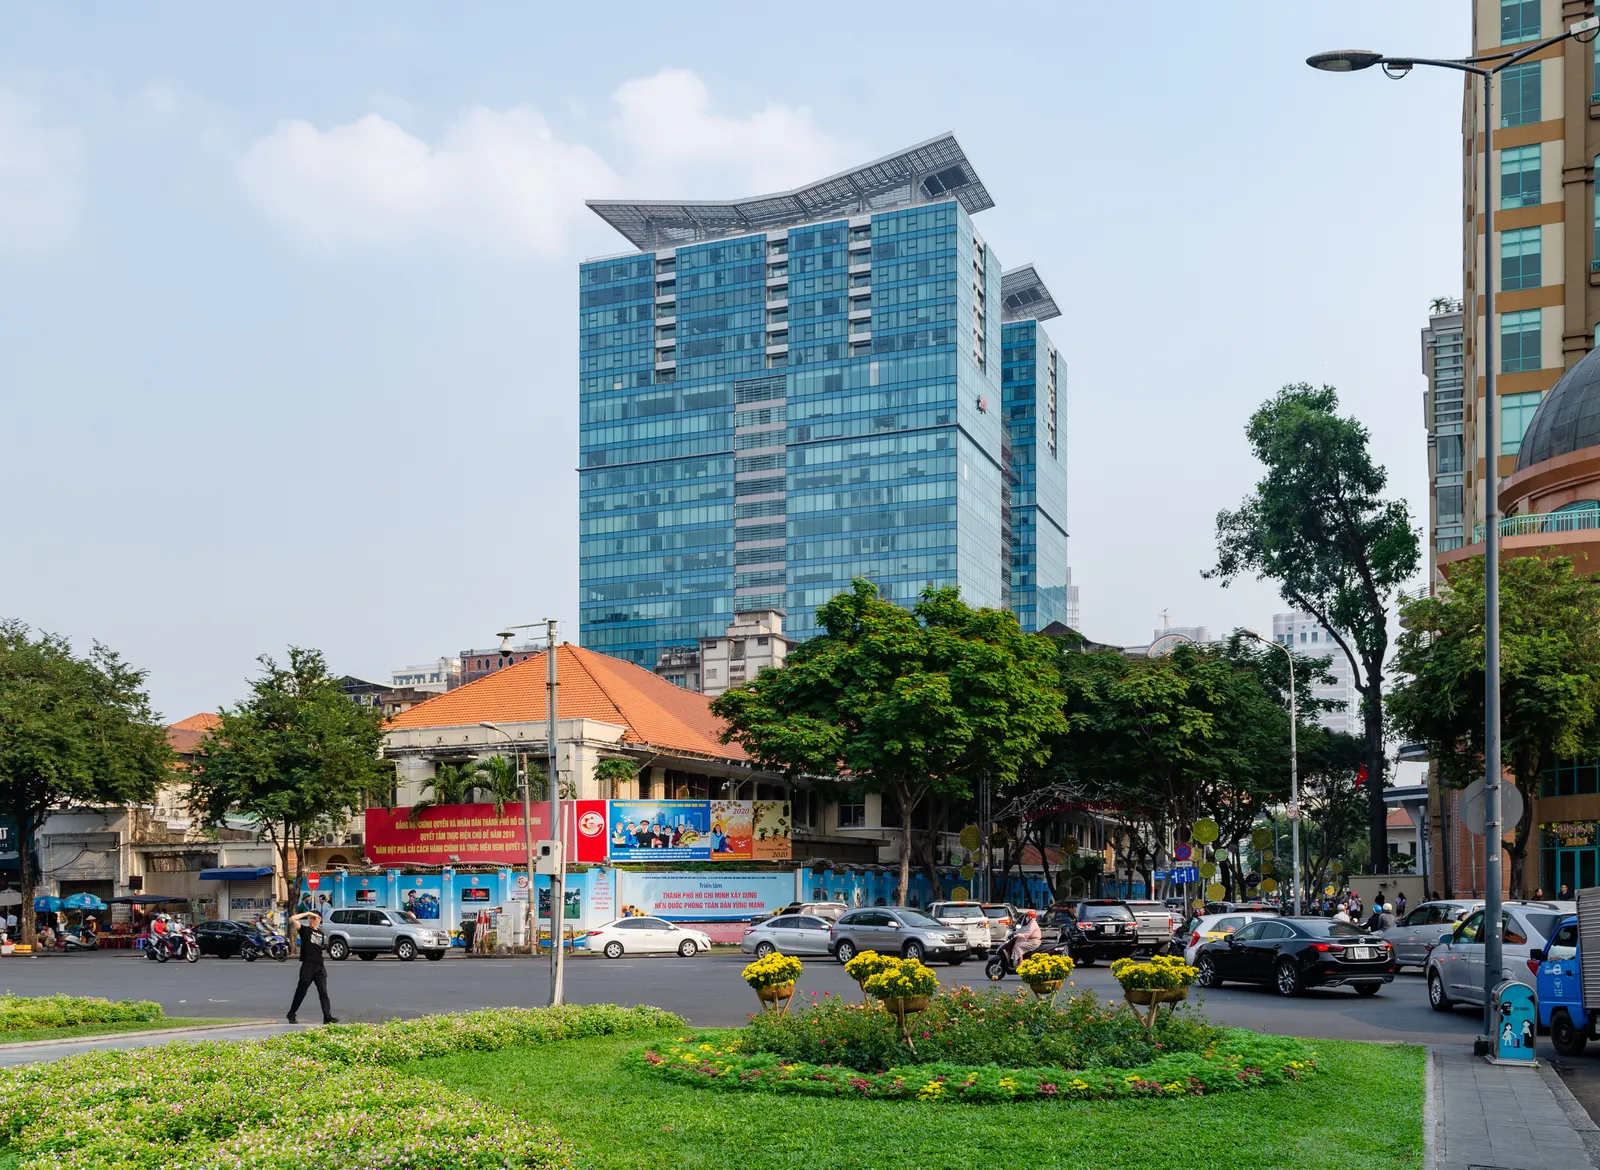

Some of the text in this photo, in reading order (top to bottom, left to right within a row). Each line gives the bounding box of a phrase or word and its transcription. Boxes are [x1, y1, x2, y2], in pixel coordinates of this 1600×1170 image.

[482, 817, 499, 826] THÀNH
[695, 890, 702, 899] HỒ
[655, 900, 666, 909] NỀN
[667, 900, 682, 909] QUỐC
